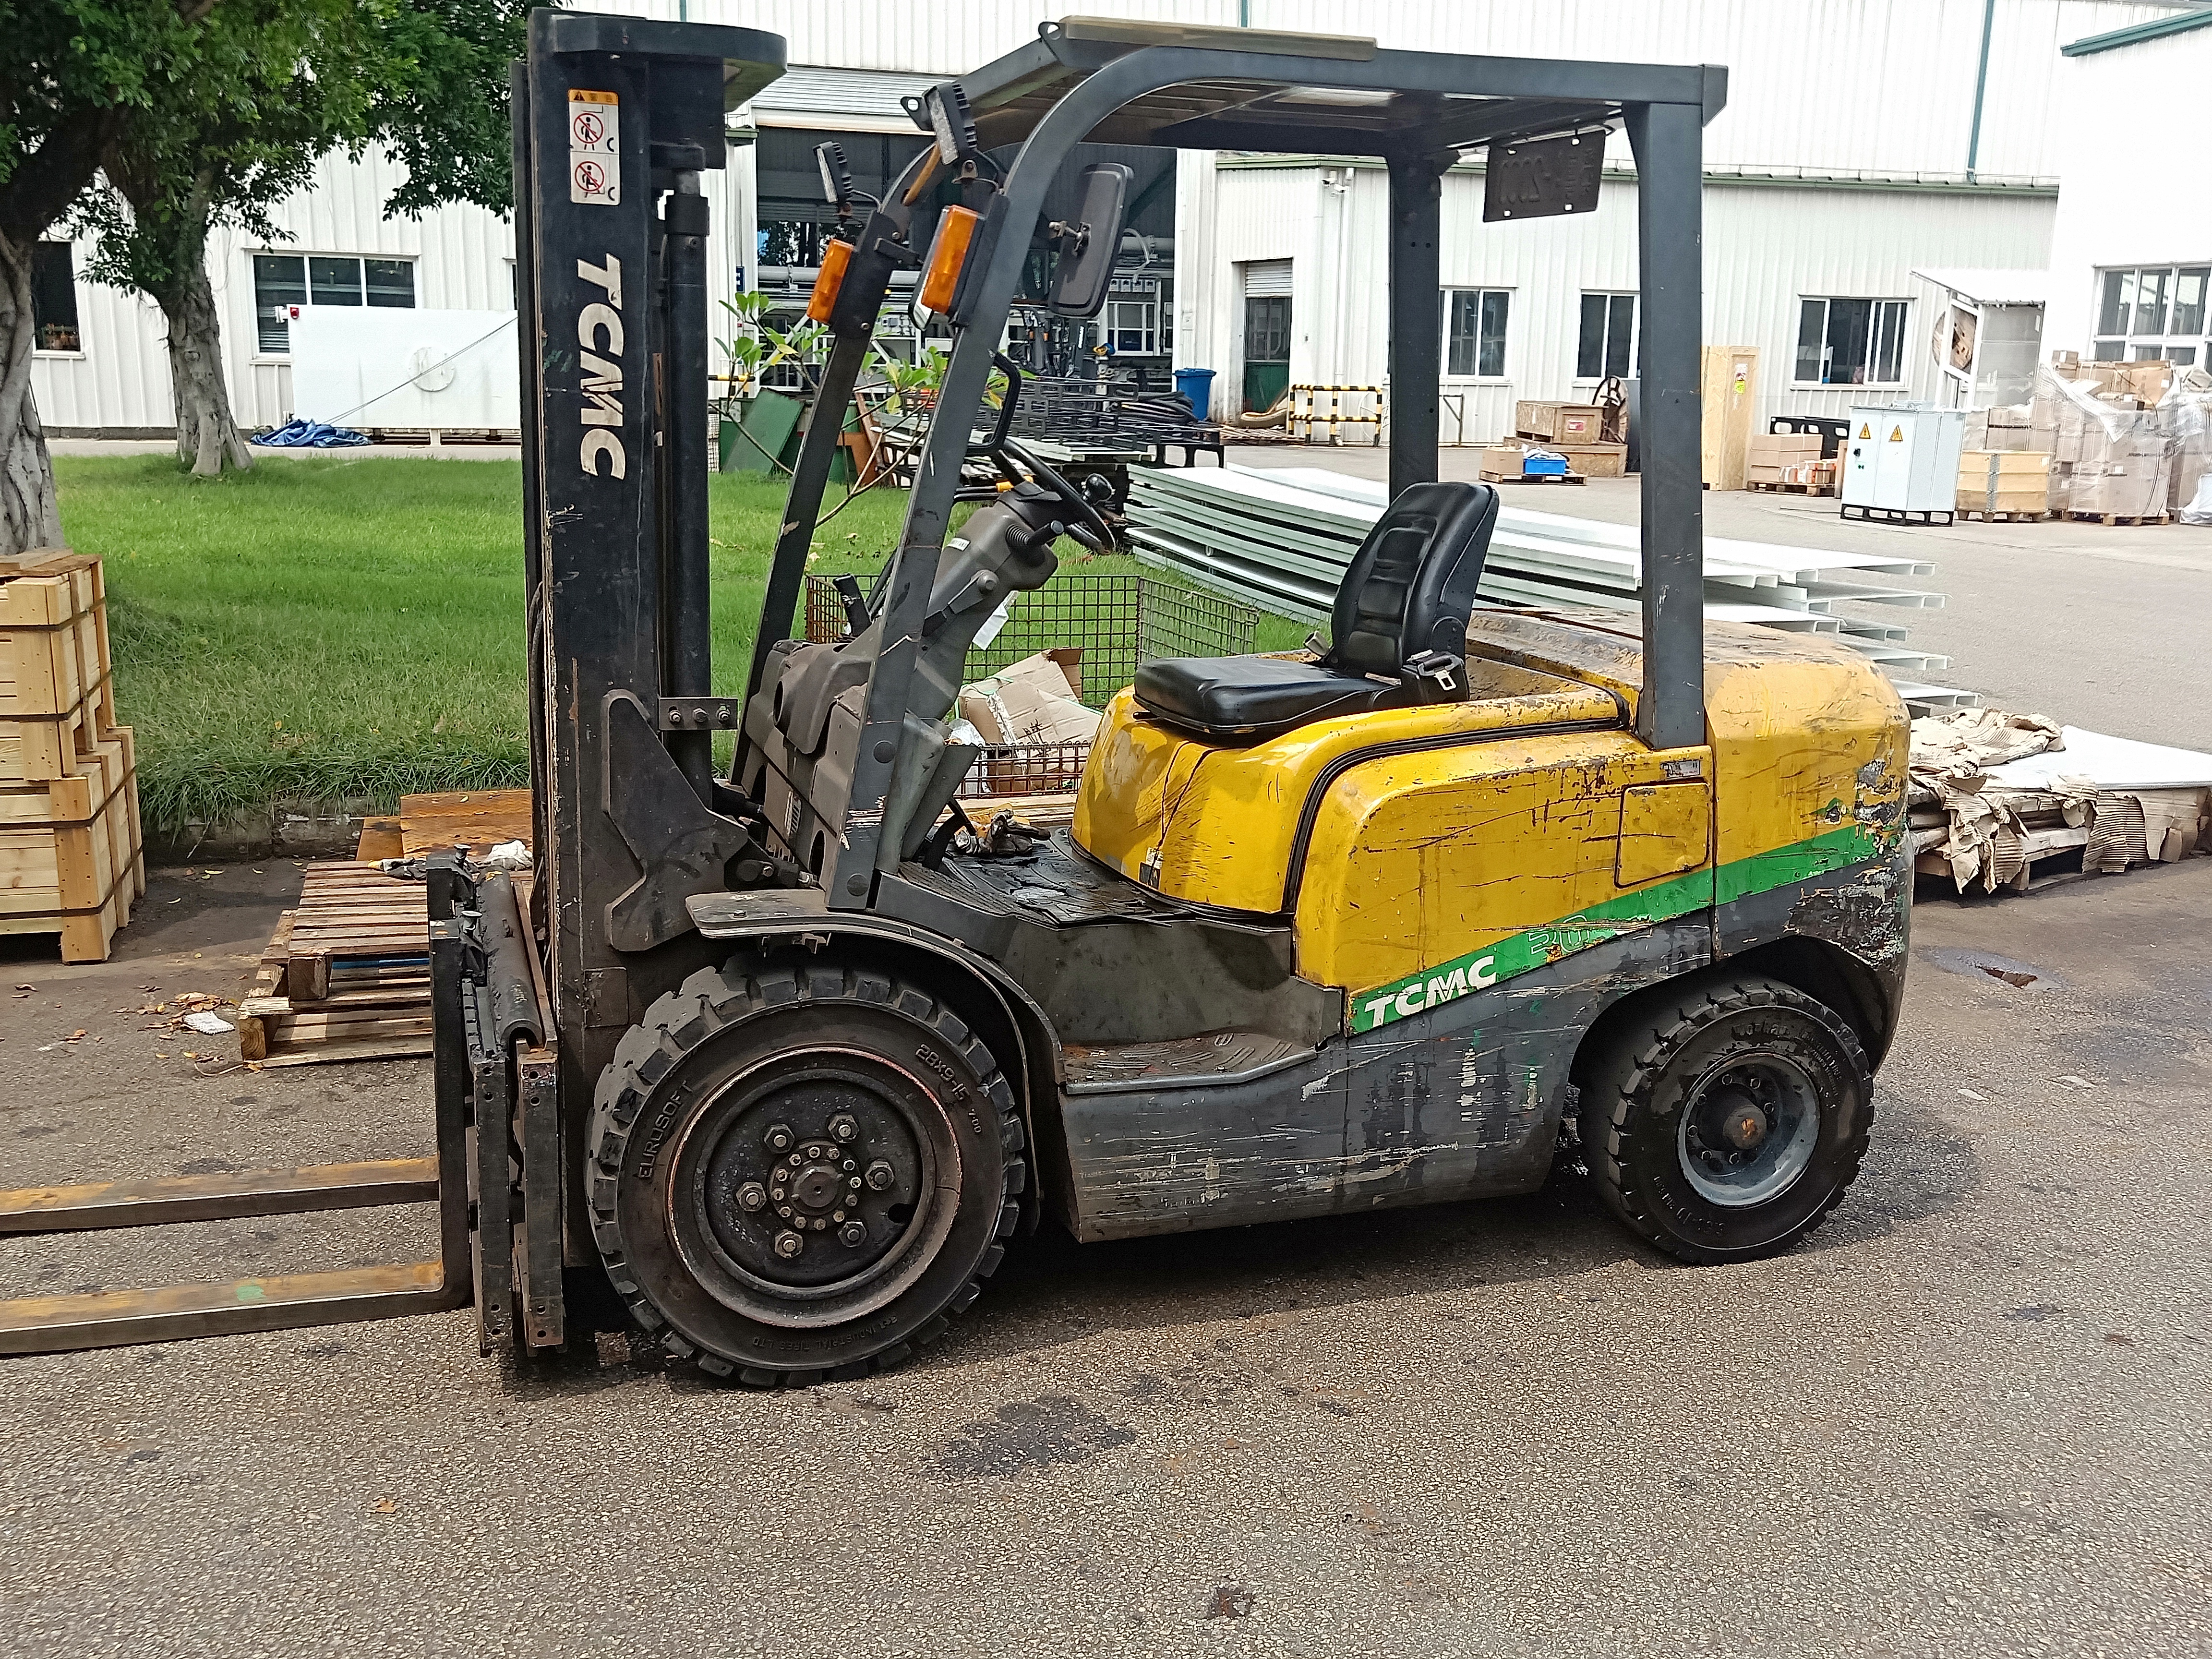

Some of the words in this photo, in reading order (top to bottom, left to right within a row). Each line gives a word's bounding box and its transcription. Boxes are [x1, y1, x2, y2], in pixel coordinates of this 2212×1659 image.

[577, 252, 626, 480] TCMC
[1364, 955, 1497, 1028] TCMC
[638, 1080, 693, 1178] EUROSOFT
[752, 1336, 774, 1348] LTD
[816, 1325, 877, 1350] INDUSTRIAL
